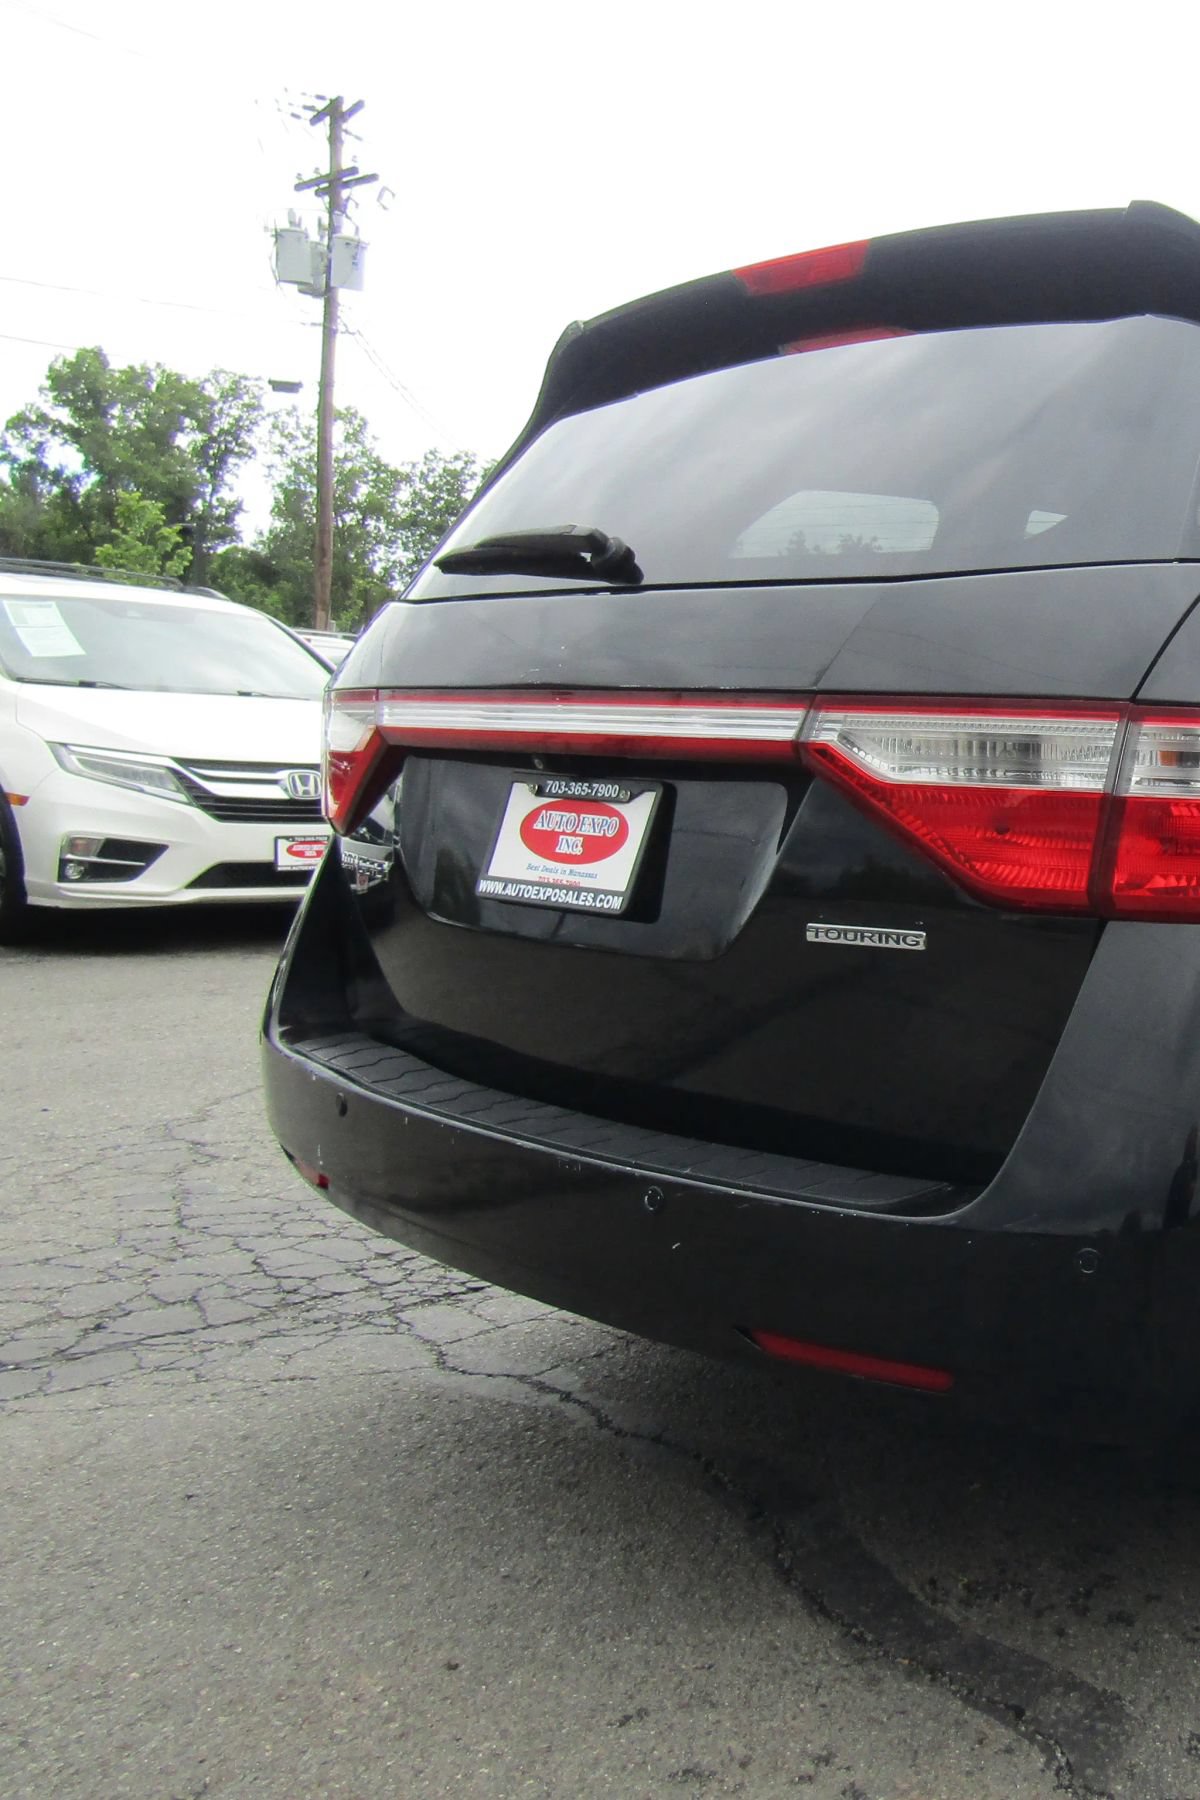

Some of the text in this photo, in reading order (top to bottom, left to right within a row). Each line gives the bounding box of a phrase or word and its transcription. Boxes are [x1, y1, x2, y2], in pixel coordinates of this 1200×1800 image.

[545, 780, 619, 798] 703-365-7900
[533, 810, 620, 837] AUTO EXPO
[555, 836, 584, 855] INC.
[526, 863, 540, 872] Best
[478, 879, 623, 910] WWW.AUTOEXPOSALES.COM
[807, 927, 921, 947] TOURING
